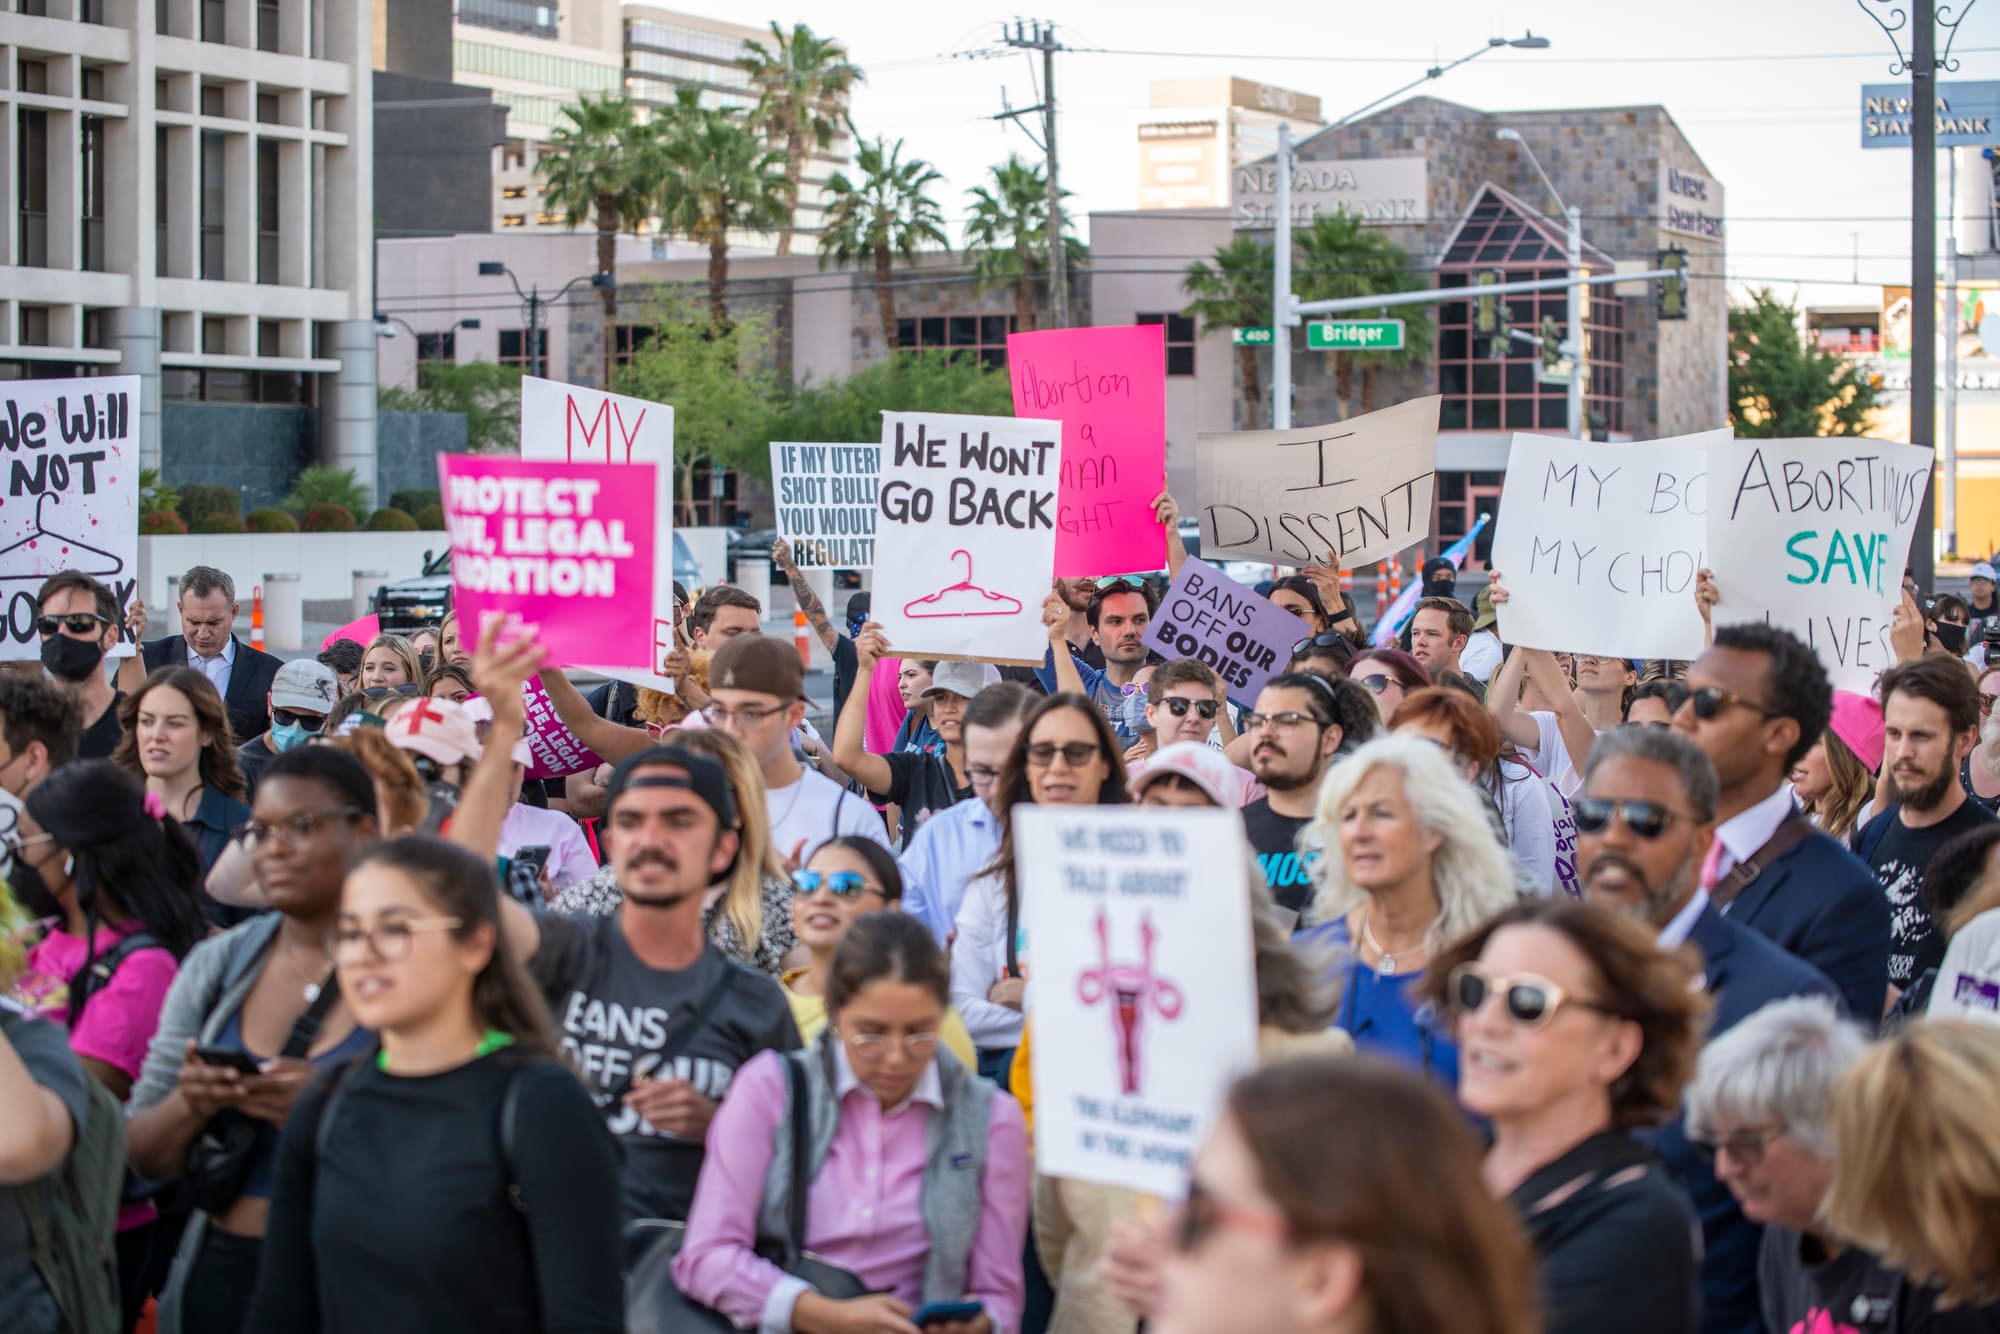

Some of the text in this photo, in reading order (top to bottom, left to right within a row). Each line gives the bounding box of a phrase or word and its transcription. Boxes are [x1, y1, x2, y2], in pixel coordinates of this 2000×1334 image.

[1866, 96, 1949, 114] NEVA
[1866, 117, 1911, 137] STAT
[1239, 167, 1358, 194] NEADA
[1239, 201, 1320, 226] STTE
[1322, 325, 1384, 345] Bridger
[1021, 360, 1130, 410] Abortion
[57, 392, 128, 444] Will
[567, 394, 646, 463] MY
[1080, 423, 1097, 449] a
[9, 451, 106, 496] NOT
[781, 446, 796, 473] IF
[800, 446, 826, 473] MY
[895, 422, 1055, 476] WE WON'T
[1276, 432, 1359, 491] I
[780, 476, 827, 504] SHOT
[881, 477, 1054, 529] GO BACK
[1543, 460, 1622, 512] MY
[503, 516, 634, 559] LEGAL
[780, 507, 815, 535] YOU
[1204, 471, 1434, 569] DISSENT
[1528, 535, 1598, 585] MY
[1785, 528, 1888, 598] SAVE
[1183, 572, 1257, 627] BANS
[1156, 620, 1254, 688] BODIES
[1171, 599, 1276, 673] OFF OUR
[1766, 610, 1890, 672] IVES
[545, 730, 584, 770] LEGAL
